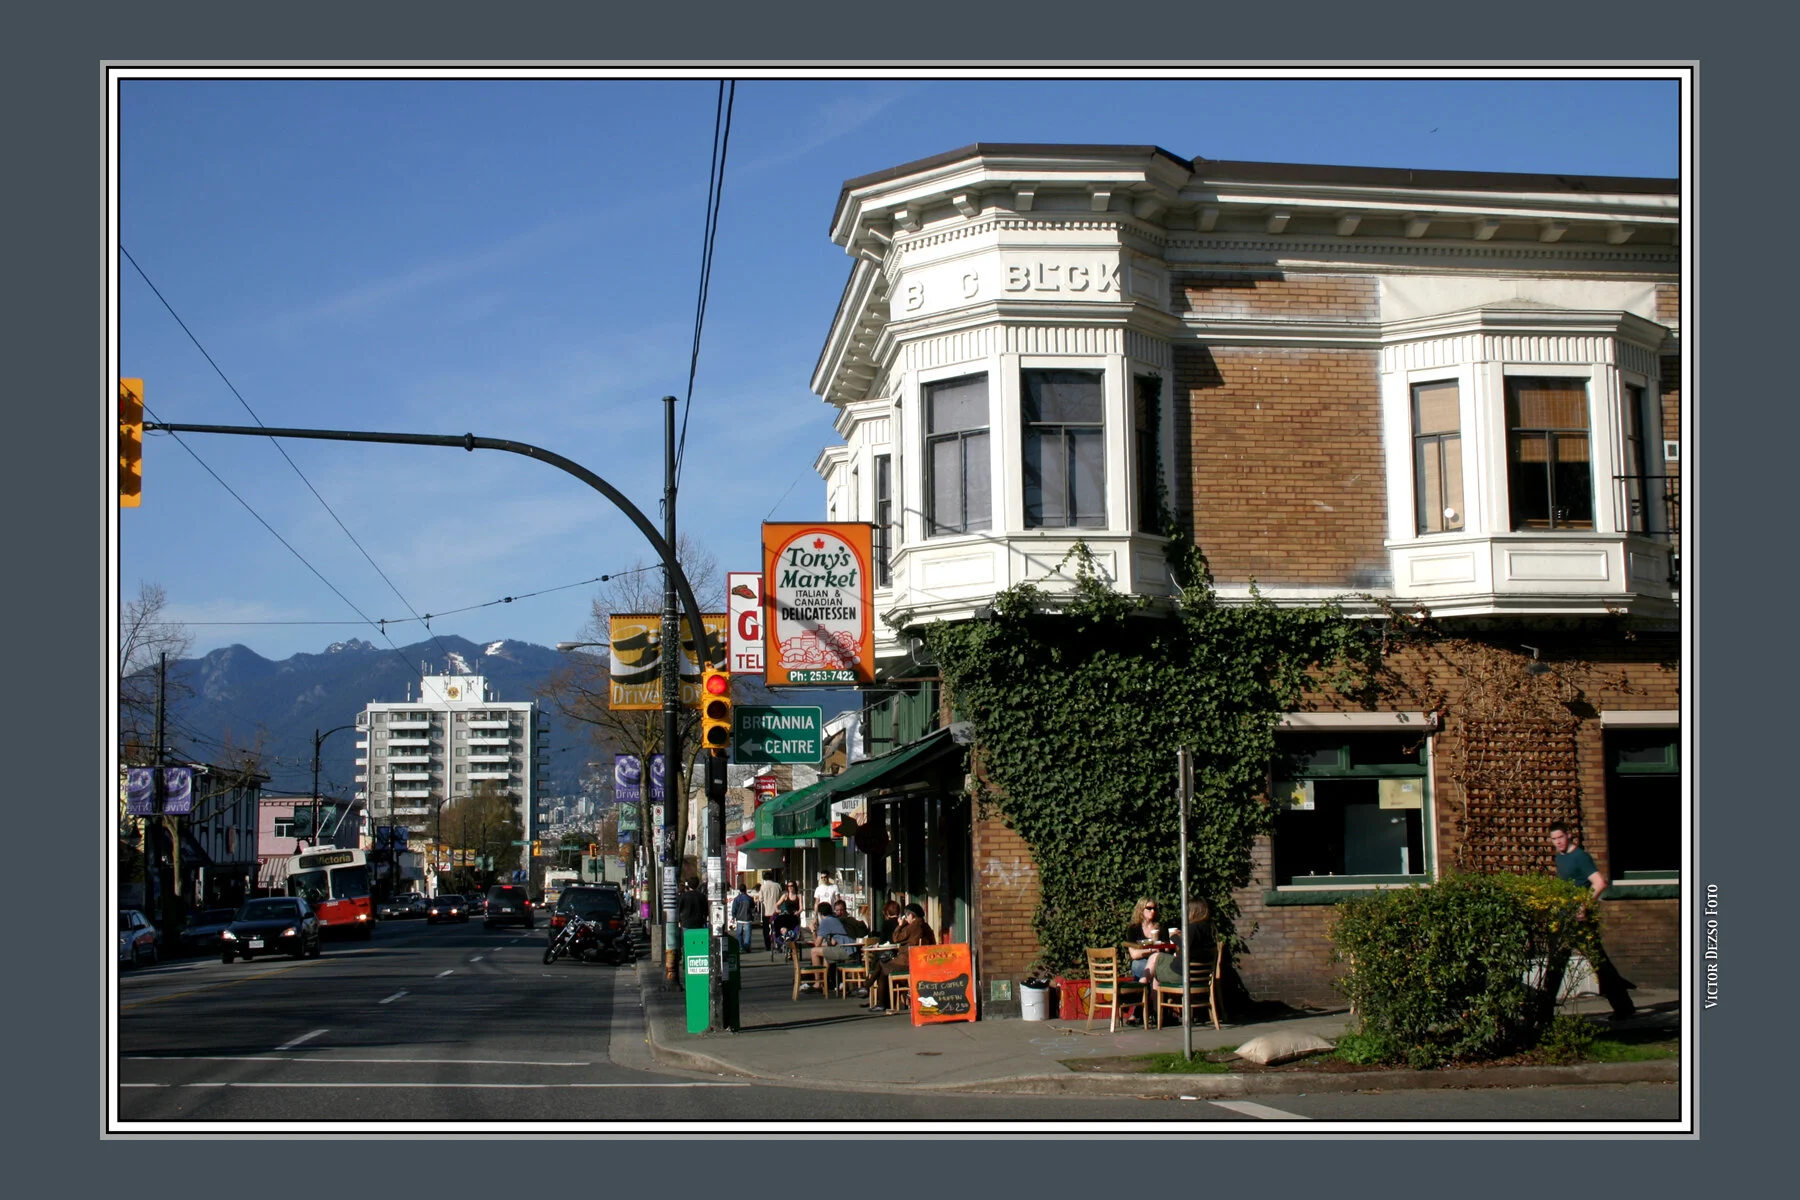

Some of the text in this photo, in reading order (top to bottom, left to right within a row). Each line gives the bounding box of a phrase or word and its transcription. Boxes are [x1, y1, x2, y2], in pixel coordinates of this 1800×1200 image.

[905, 280, 925, 312] B
[961, 266, 980, 299] C
[786, 546, 851, 571] Tony's
[779, 568, 857, 588] Market
[796, 590, 841, 598] ITALIAN &
[795, 599, 843, 607] CANADIAN
[782, 607, 857, 621] DELICATESSEN
[790, 671, 855, 682] Ph: 253-7422
[613, 685, 660, 705] Drive
[742, 716, 815, 730] BRITANNIA
[765, 740, 815, 754] CENTRE
[615, 788, 640, 799] Drive
[690, 958, 709, 967] metro
